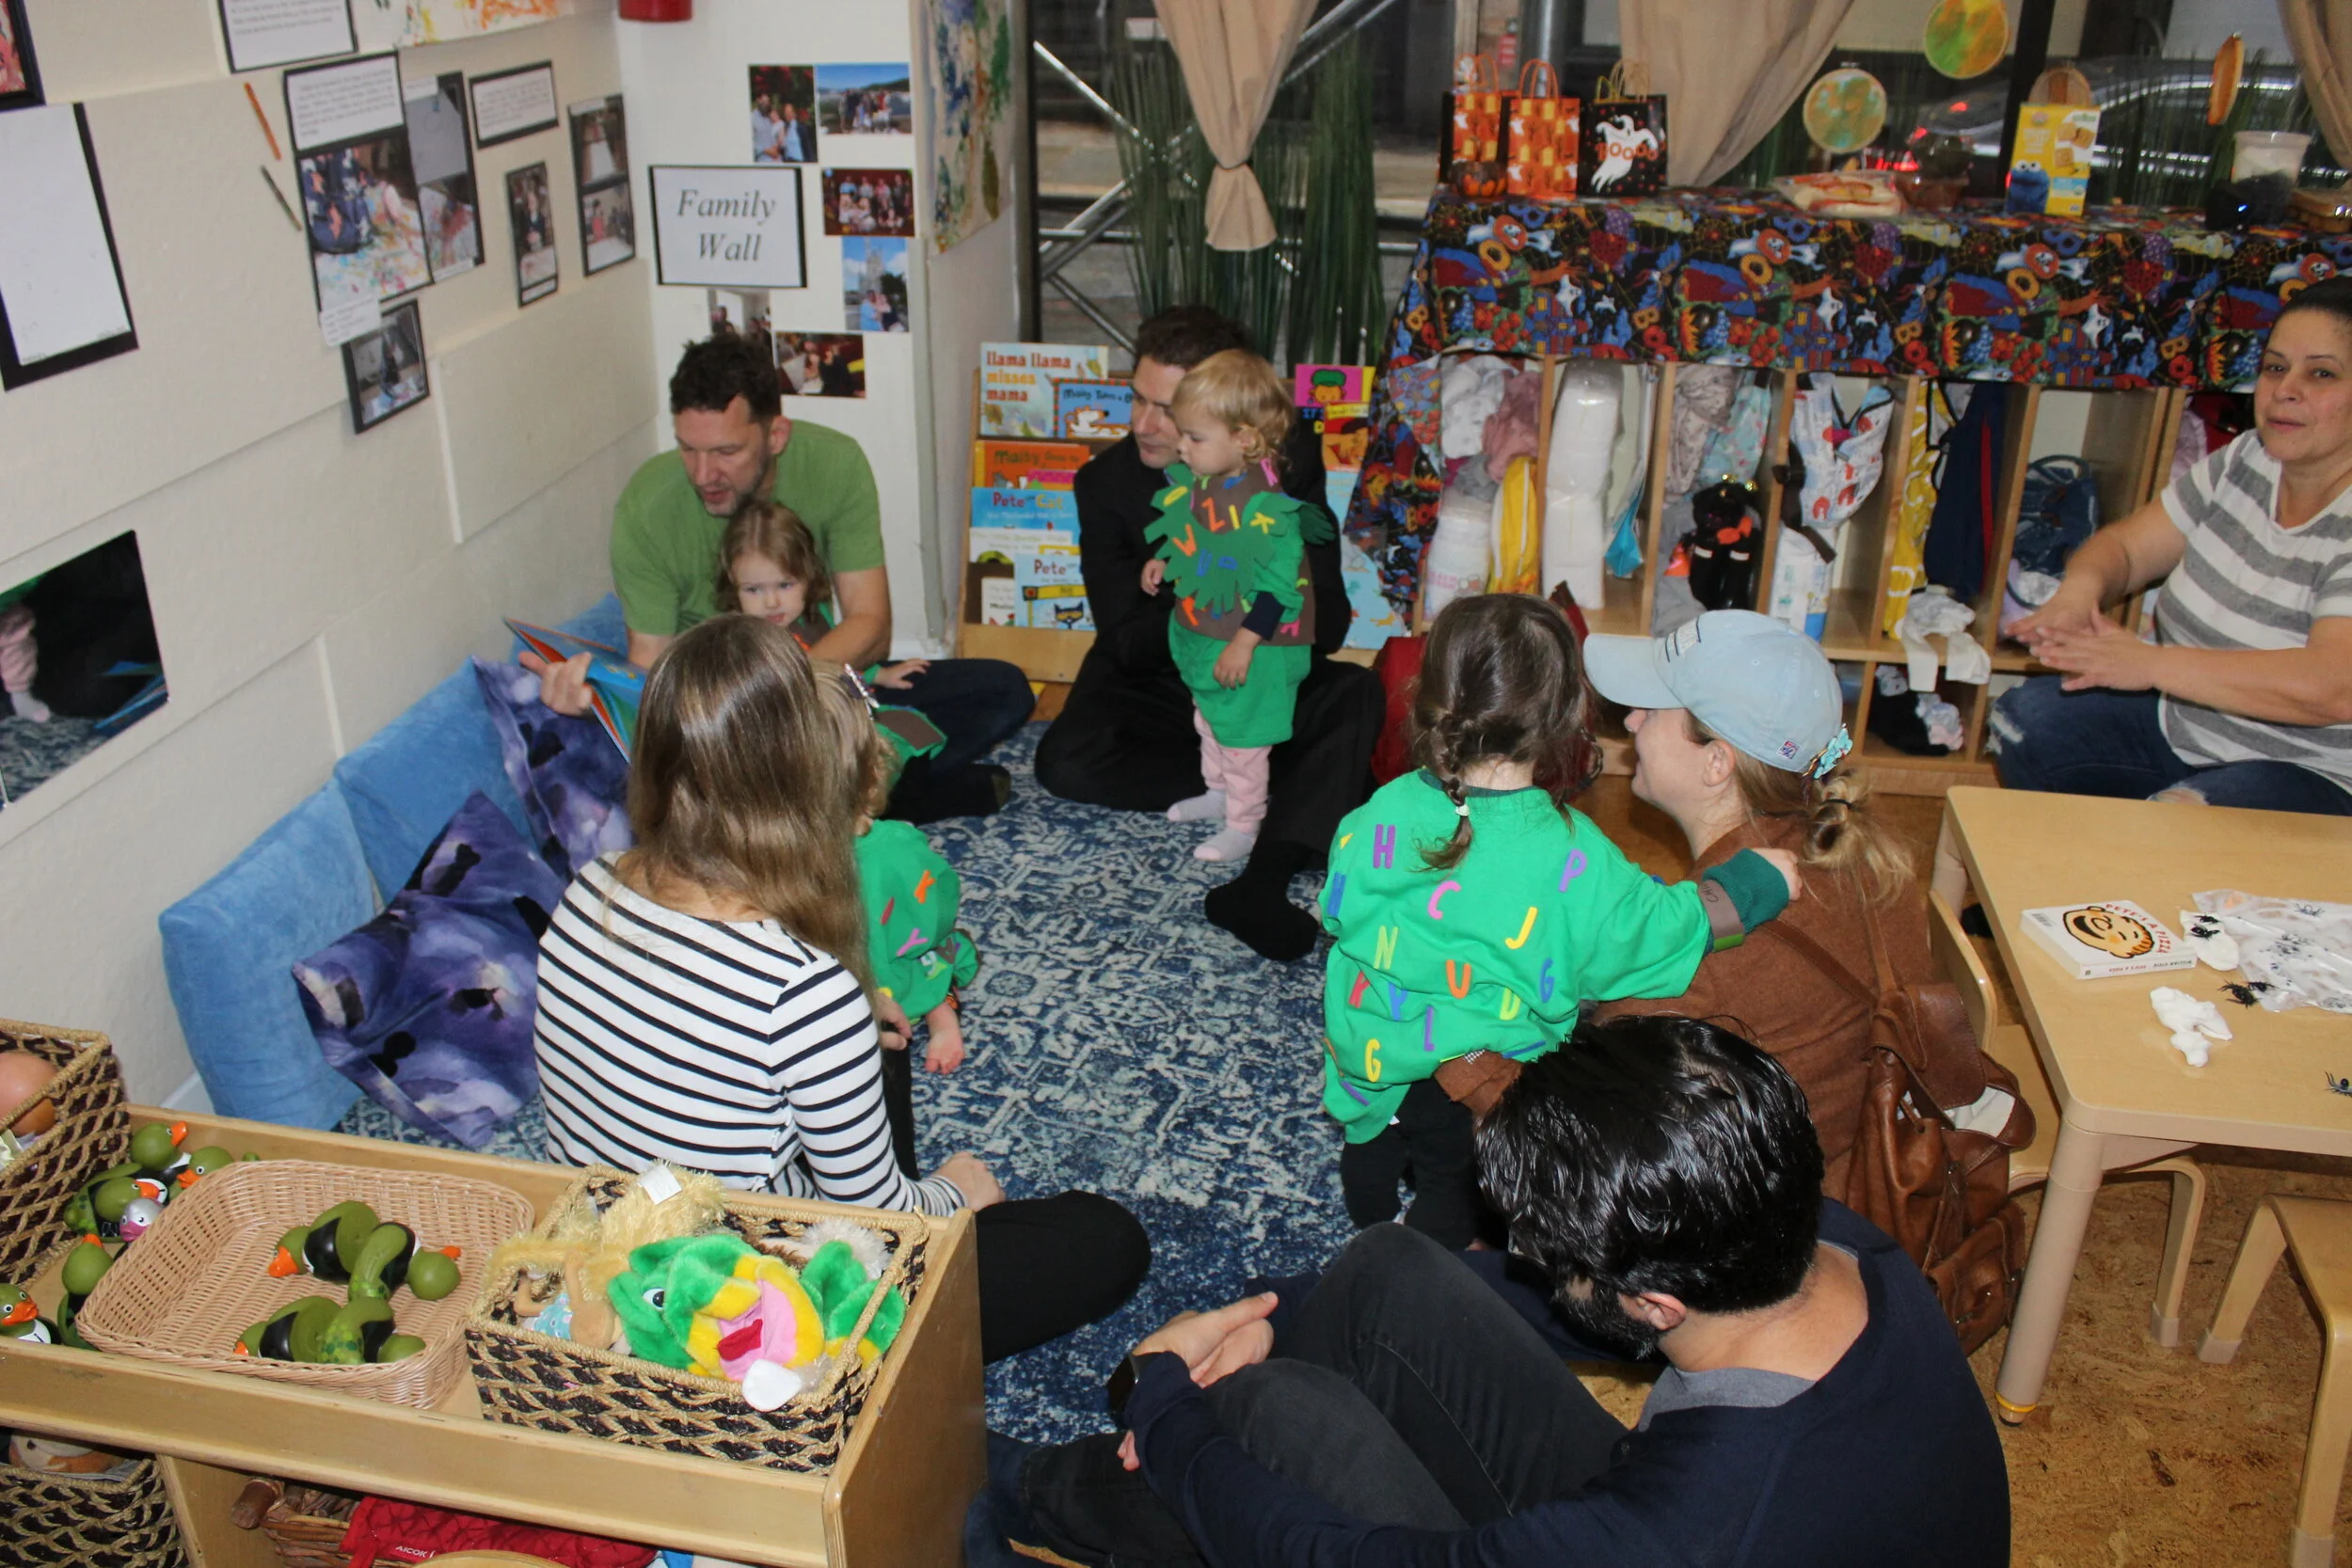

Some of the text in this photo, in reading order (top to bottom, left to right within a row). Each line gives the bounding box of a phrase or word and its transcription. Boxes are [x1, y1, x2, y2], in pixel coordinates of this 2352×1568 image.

[676, 188, 778, 226] Family
[699, 232, 762, 261] Wall
[986, 351, 1072, 370] llama llama
[986, 388, 1028, 403] mama
[993, 491, 1065, 511] Pete Cat
[1034, 558, 1067, 576] Pete
[1372, 823, 1397, 870] H
[1557, 847, 1588, 894] P
[1426, 879, 1462, 921] C
[1373, 925, 1400, 971] N
[1504, 906, 1538, 950] J
[2106, 903, 2148, 922] PETE'S
[2155, 930, 2171, 954] PIZZA
[1445, 958, 1472, 1000] U
[1364, 1037, 1382, 1083] G
[395, 1544, 428, 1559] AICOK
